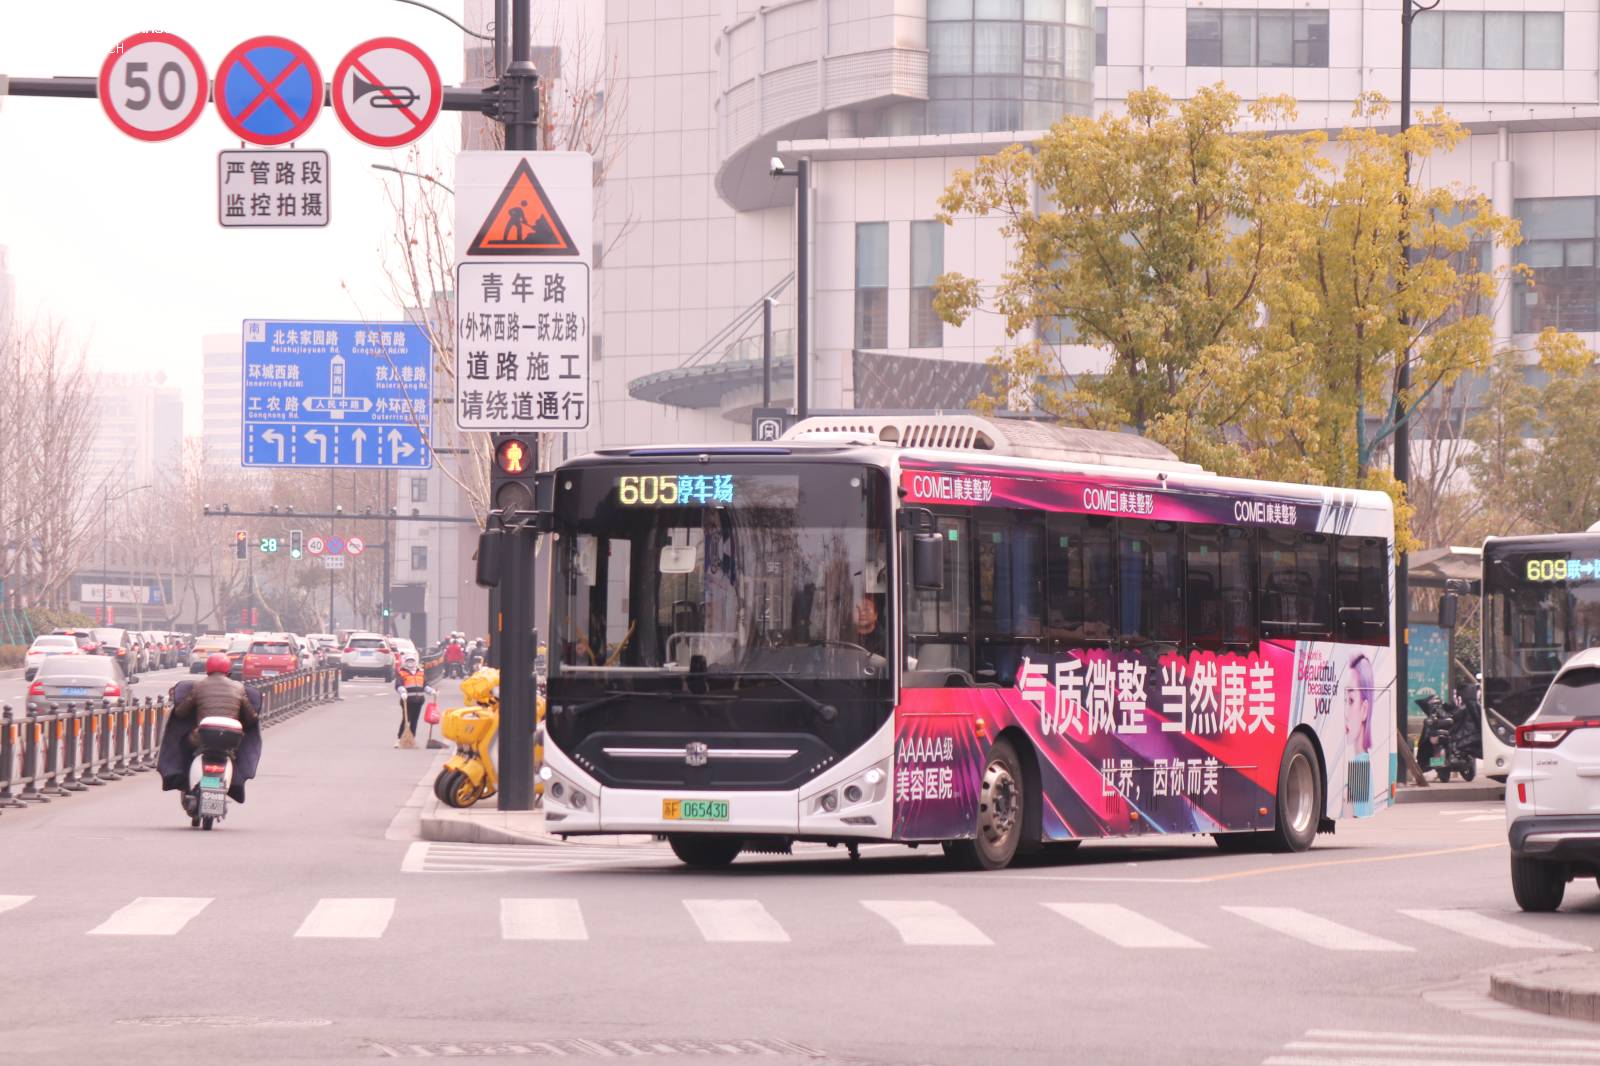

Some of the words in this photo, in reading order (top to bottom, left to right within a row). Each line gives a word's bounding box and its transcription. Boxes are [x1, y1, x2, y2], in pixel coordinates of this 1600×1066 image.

[124, 61, 186, 111] 50
[225, 160, 323, 185] 严管路段
[225, 192, 323, 217] 监控拍摄
[481, 272, 567, 304] 青年路
[354, 330, 406, 347] 青年西路
[248, 363, 300, 380] 环城西路
[466, 350, 581, 382] 道路施工
[248, 395, 299, 412] 工农路
[316, 399, 359, 409] 人民中路
[375, 397, 426, 414] 外环西路
[461, 390, 584, 421] 请绕道通行
[260, 538, 277, 552] 28
[310, 541, 322, 550] 40
[1019, 656, 1149, 737] 气质微整
[1160, 660, 1276, 737] 当然康美
[1306, 681, 1331, 696] because
[1331, 680, 1339, 697] of
[1313, 697, 1331, 720] you
[897, 736, 954, 764] AAAAA级
[896, 766, 953, 803] 美容医院
